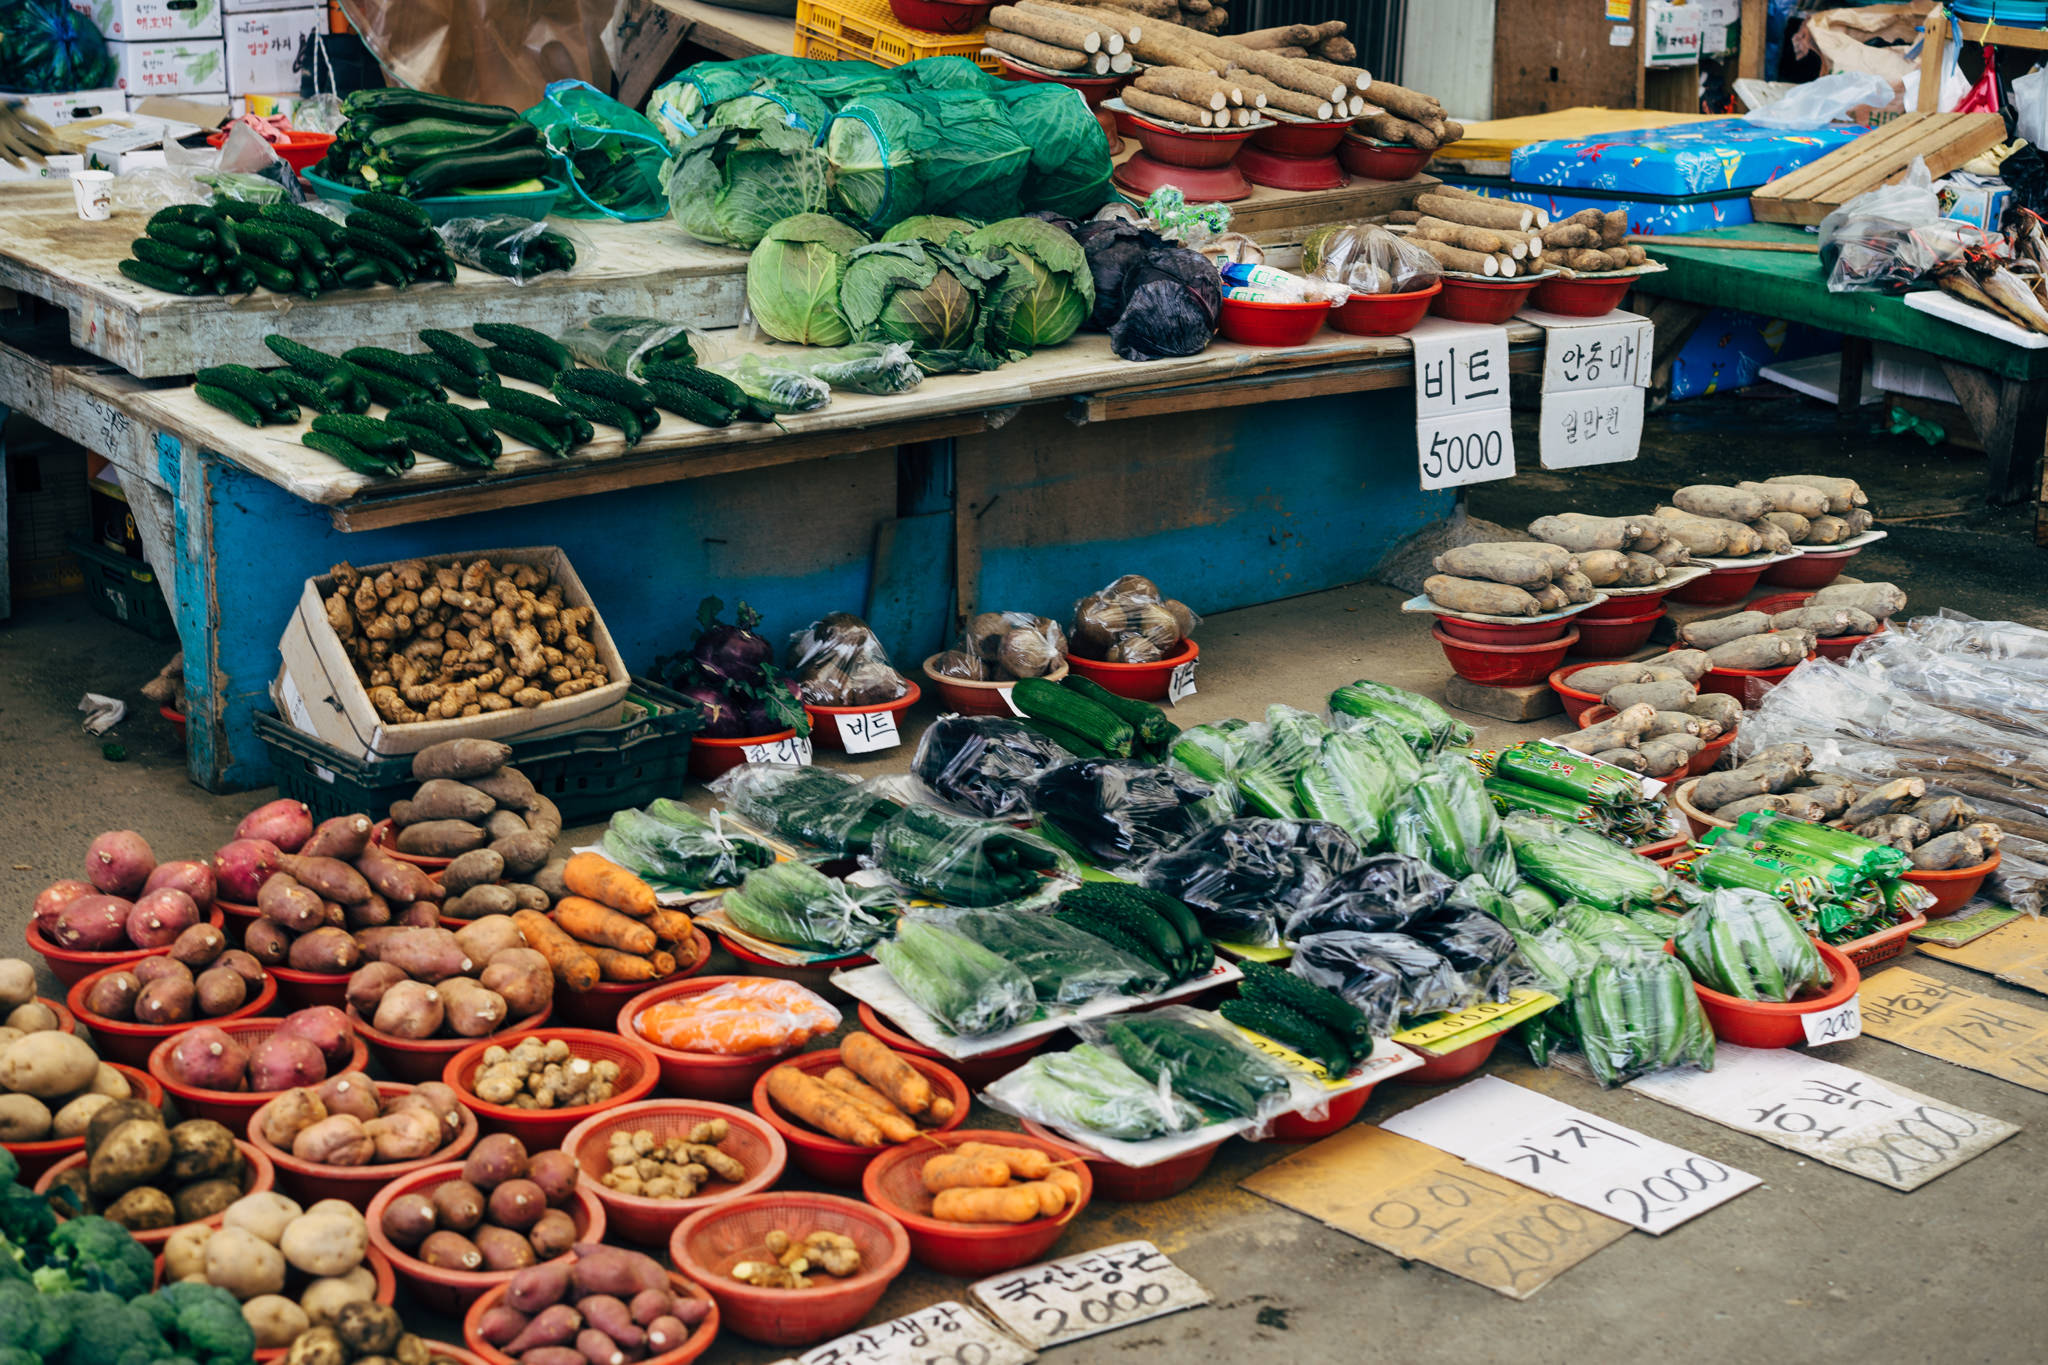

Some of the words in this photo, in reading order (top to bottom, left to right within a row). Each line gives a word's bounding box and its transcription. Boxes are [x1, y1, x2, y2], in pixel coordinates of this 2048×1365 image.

[142, 71, 178, 87] 애호박
[1425, 347, 1500, 406] 비트
[1562, 336, 1634, 382] 안동마
[1561, 405, 1619, 445] 일만원
[1423, 430, 1503, 478] 5000
[846, 713, 896, 742] 비트
[1860, 977, 1974, 1024] 애호박
[1747, 1080, 1894, 1142] 호박
[1505, 1118, 1641, 1175] 가지
[1845, 1106, 1979, 1183] 2000
[1369, 1169, 1508, 1245] 오이
[1605, 1157, 1730, 1224] 2000
[1465, 1203, 1588, 1287] 2000
[1033, 1282, 1170, 1337] 2000
